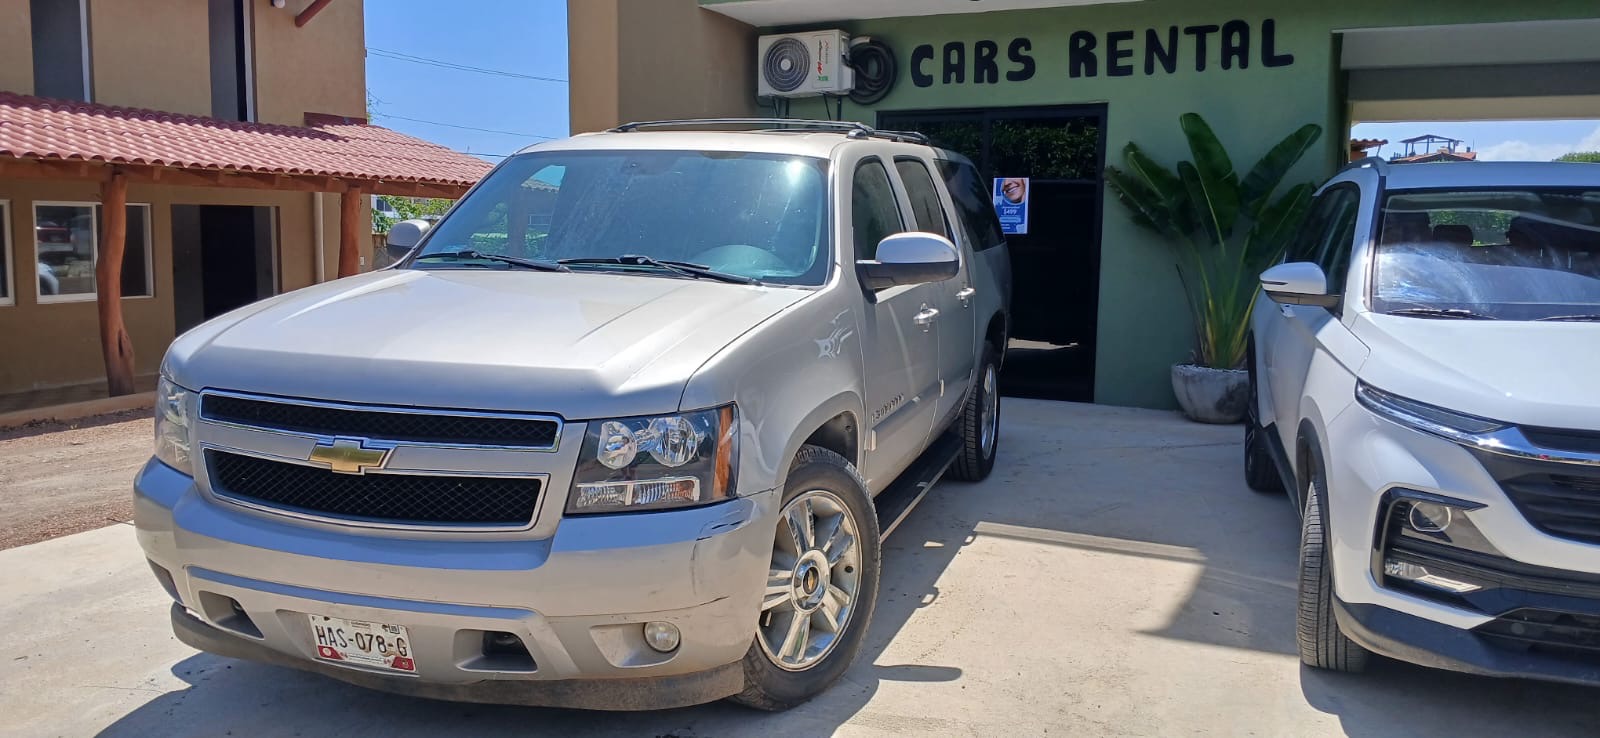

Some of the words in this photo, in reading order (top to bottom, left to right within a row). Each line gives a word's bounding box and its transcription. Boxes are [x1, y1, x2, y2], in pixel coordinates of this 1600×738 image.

[910, 37, 1036, 88] CARS
[1068, 18, 1294, 78] RENTAL
[314, 625, 408, 657] HAS-078-G
